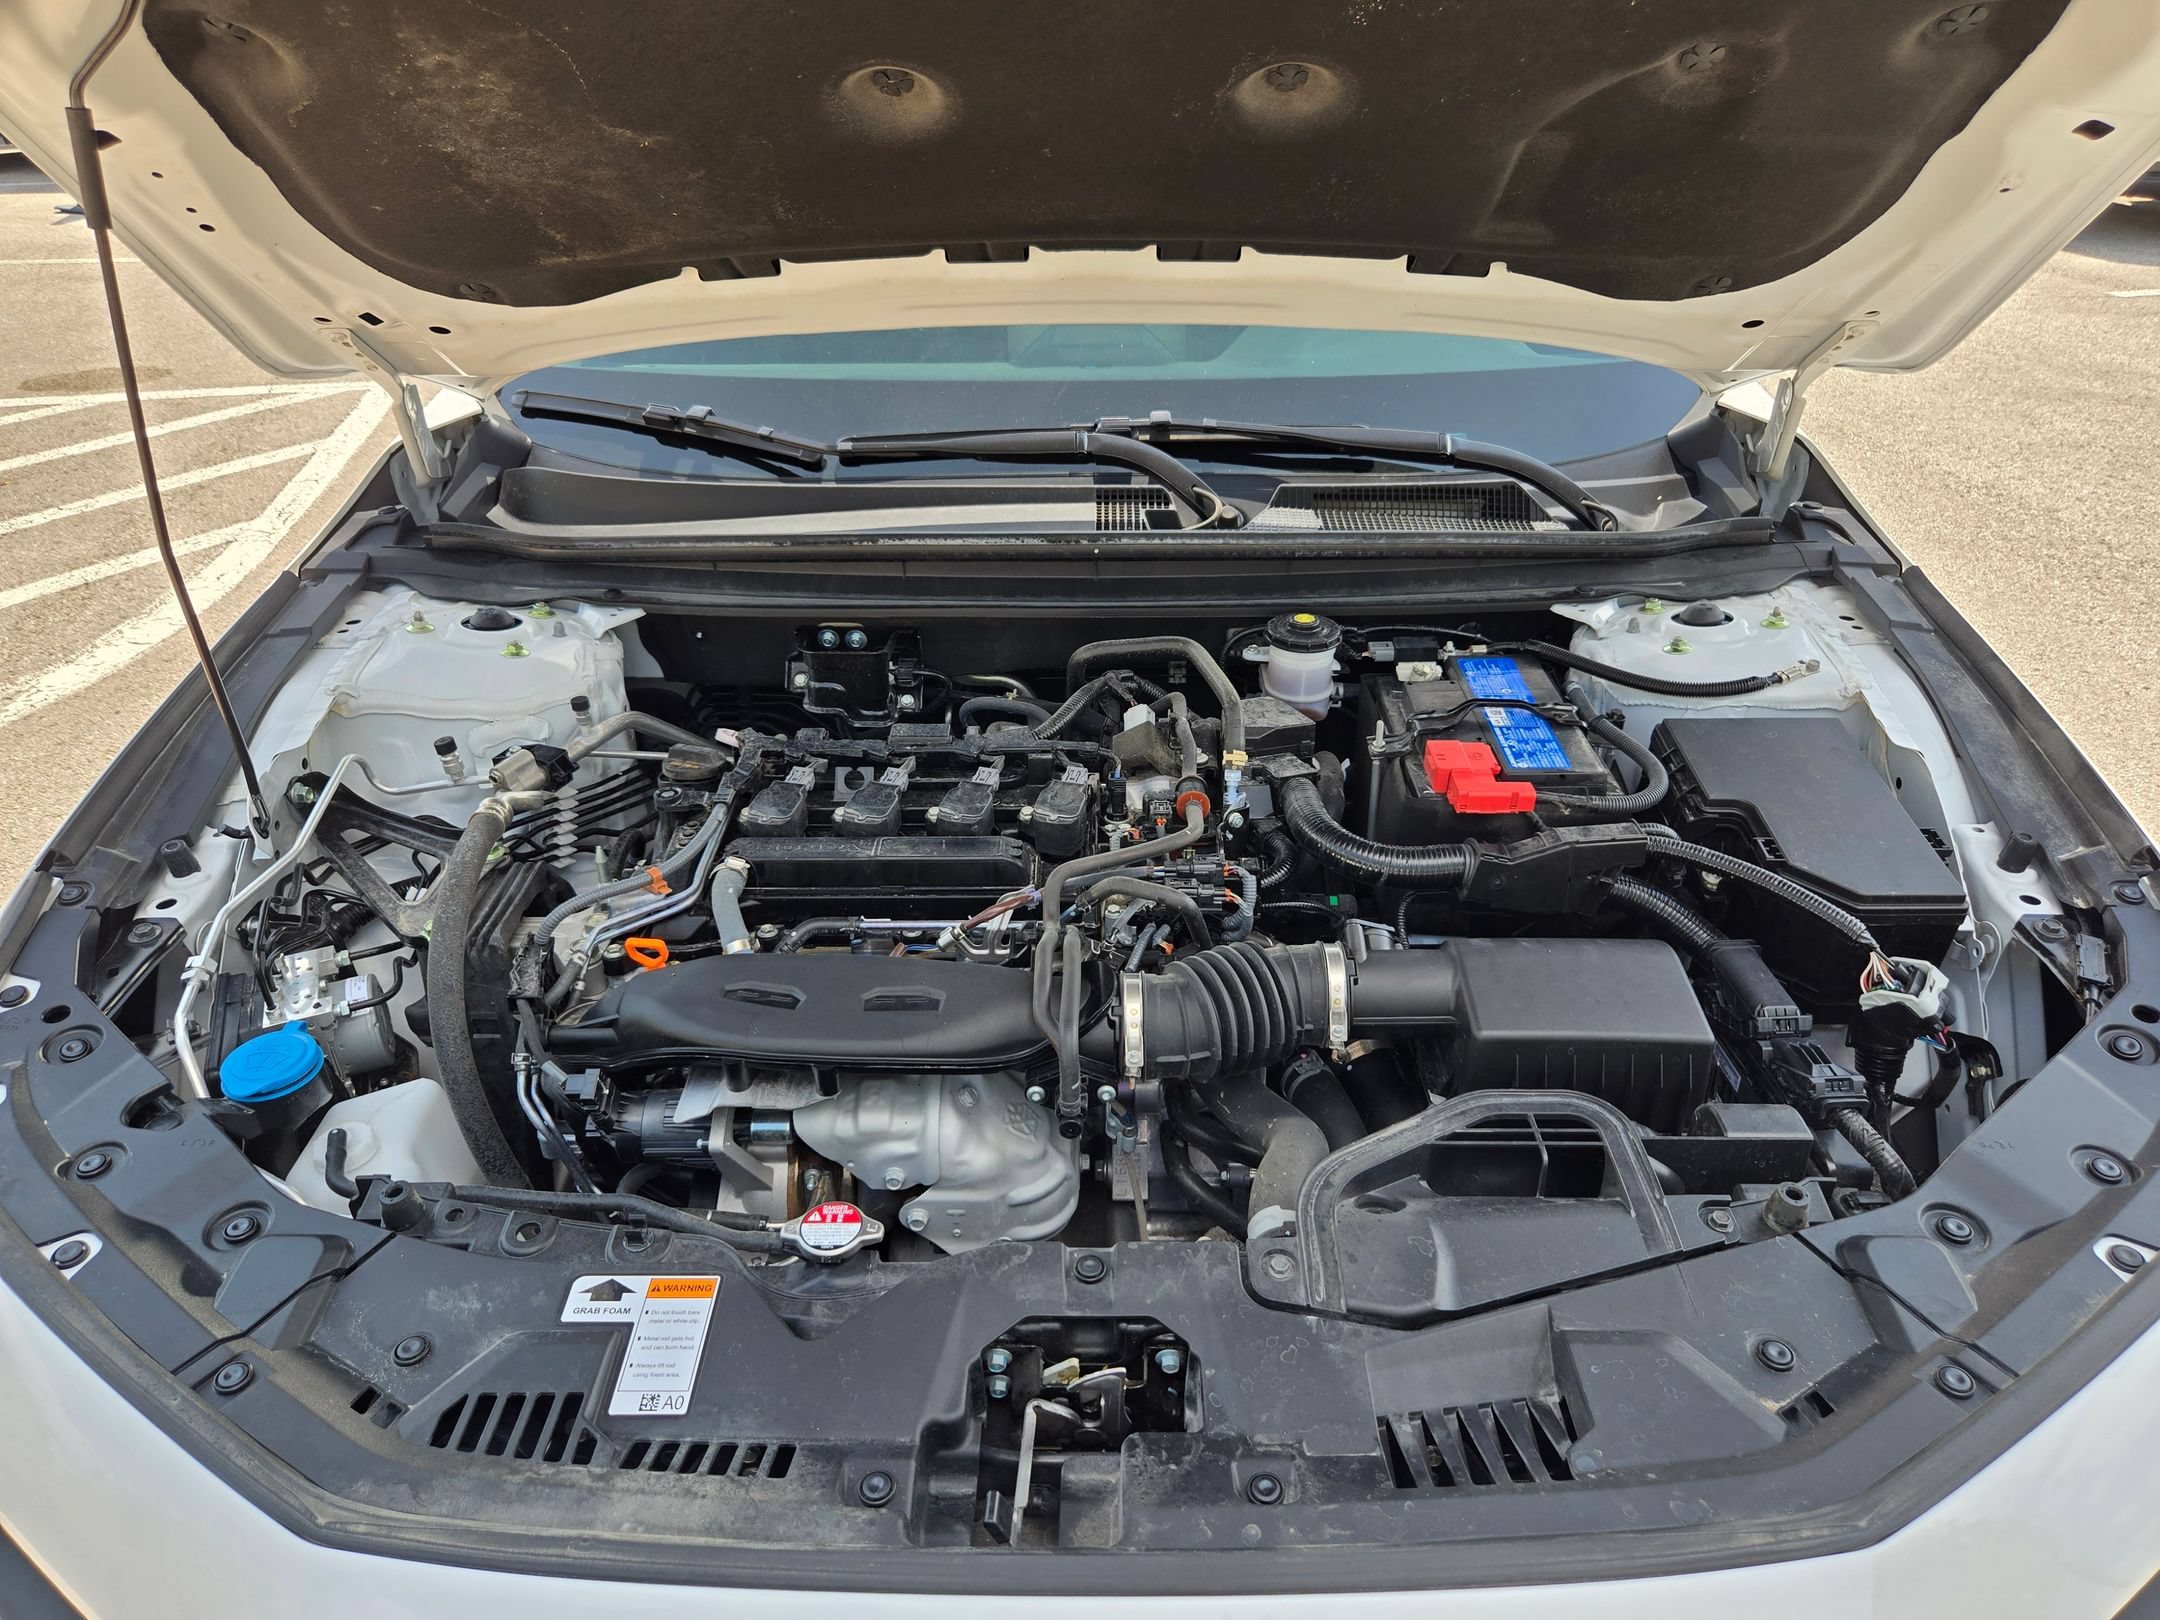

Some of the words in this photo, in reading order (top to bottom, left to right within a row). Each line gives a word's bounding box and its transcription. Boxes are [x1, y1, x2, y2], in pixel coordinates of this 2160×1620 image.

[662, 1284, 713, 1292] WARNING
[572, 1307, 601, 1315] GRAB
[602, 1307, 632, 1315] FOAM
[661, 1395, 685, 1410] A0
